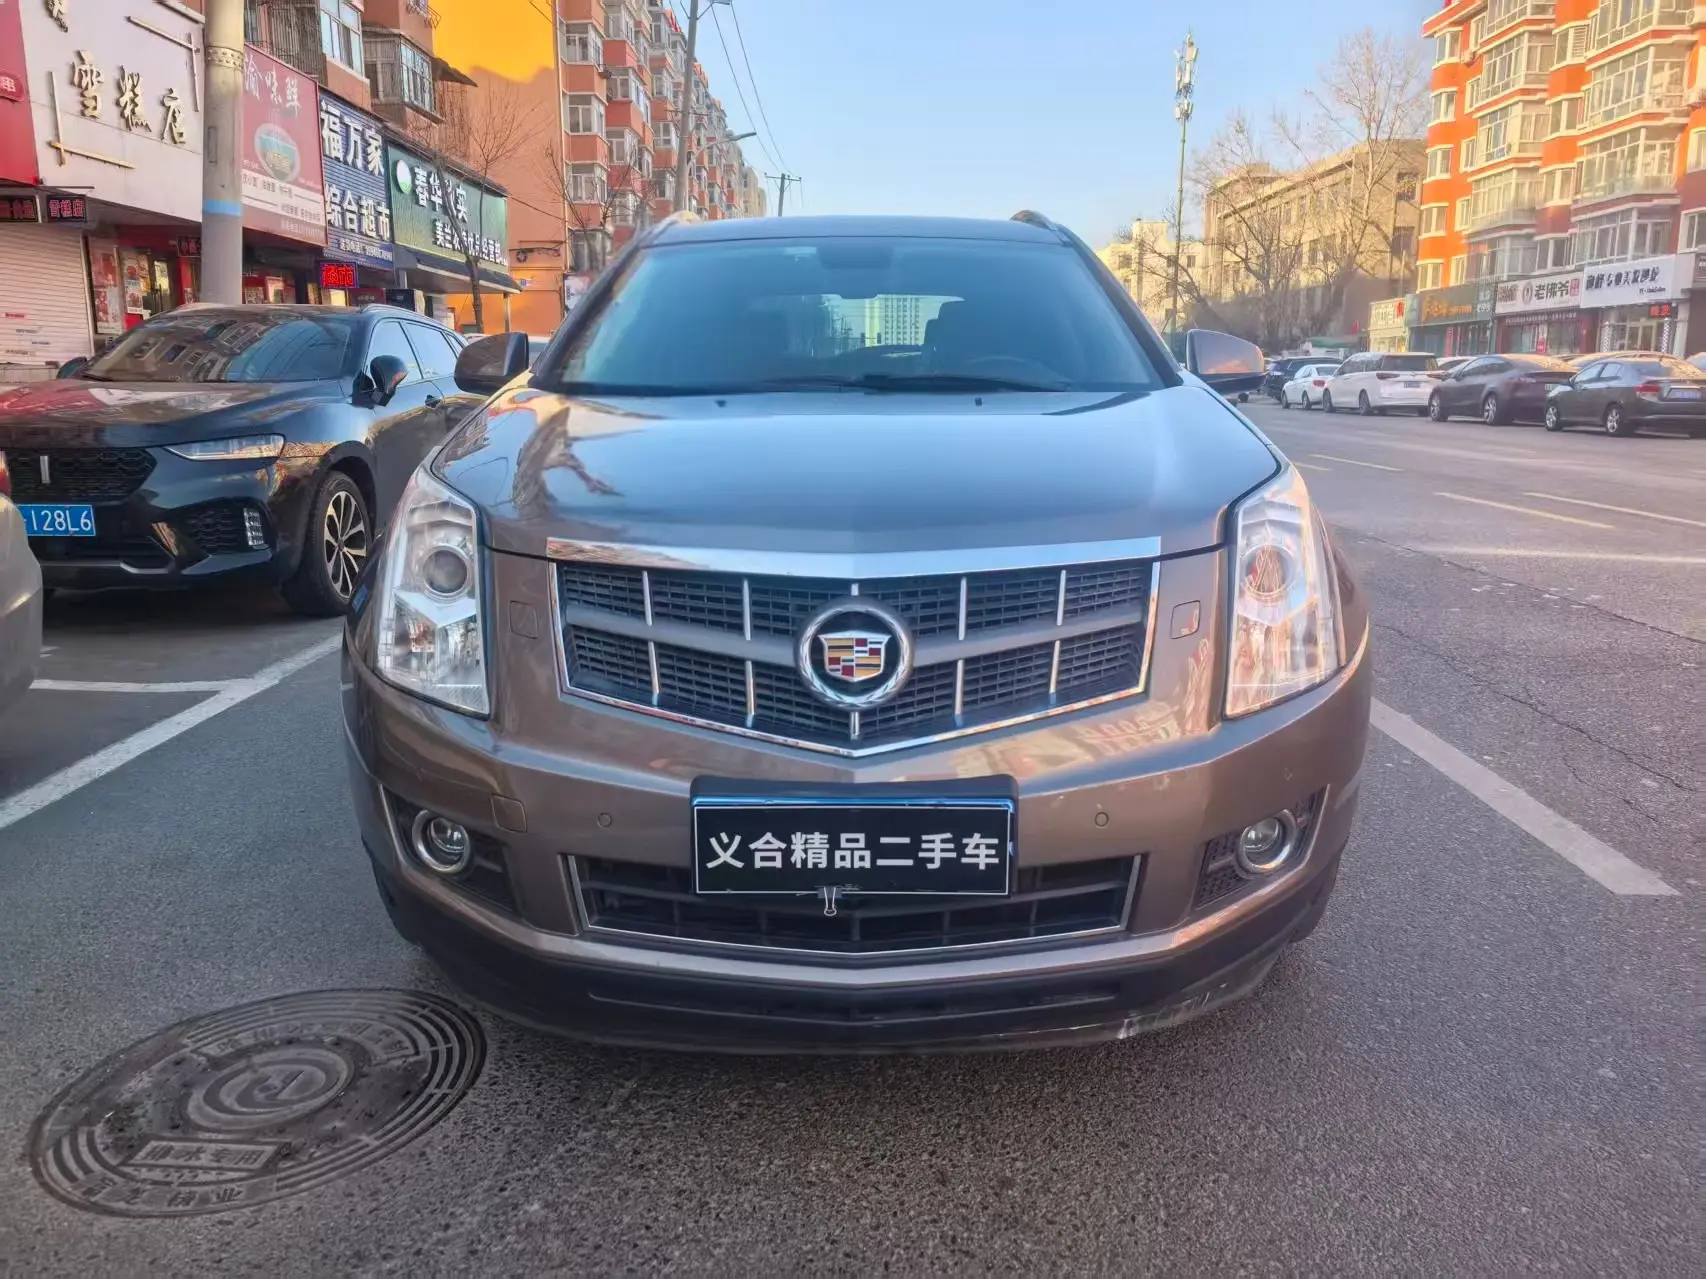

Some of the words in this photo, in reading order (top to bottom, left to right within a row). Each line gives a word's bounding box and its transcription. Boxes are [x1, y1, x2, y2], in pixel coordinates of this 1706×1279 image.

[70, 49, 187, 145] 雪糕店
[319, 99, 386, 176] 福万家
[323, 183, 391, 241] 综合超市
[31, 509, 92, 531] 128L6
[706, 832, 1000, 870] 义合精品二手车
